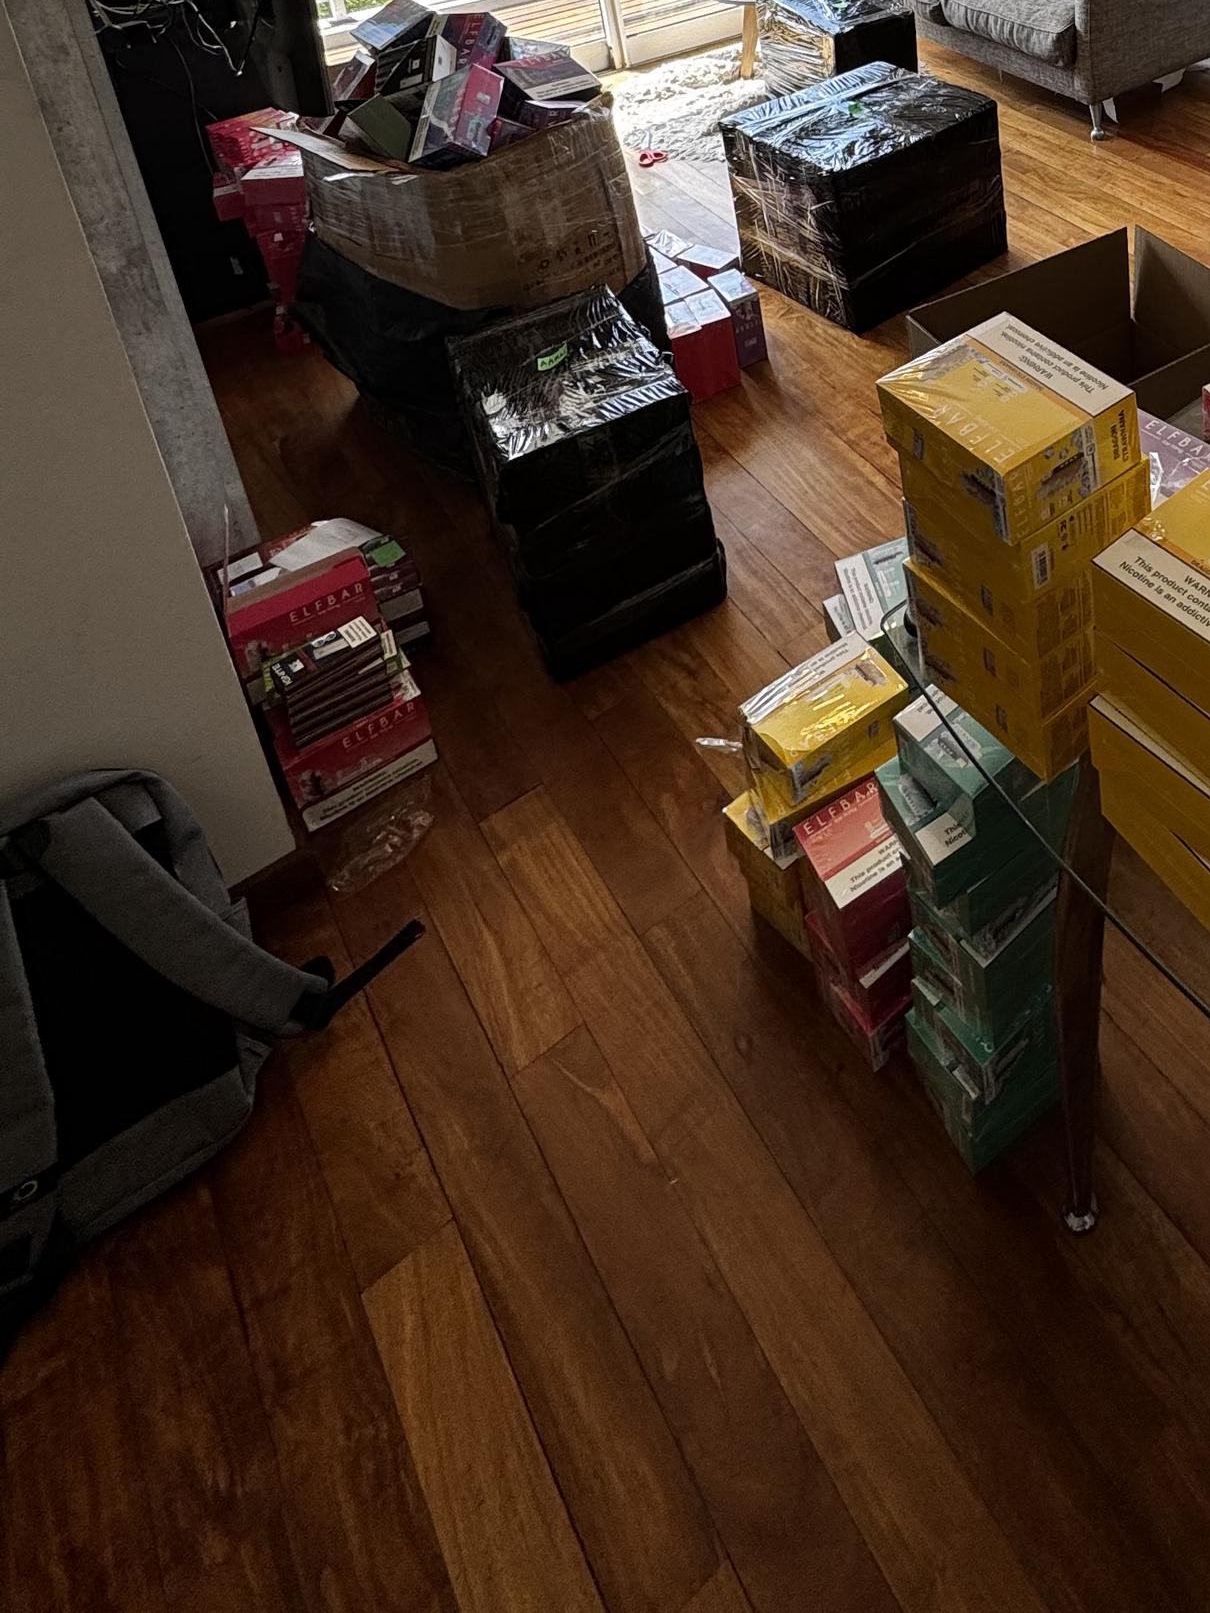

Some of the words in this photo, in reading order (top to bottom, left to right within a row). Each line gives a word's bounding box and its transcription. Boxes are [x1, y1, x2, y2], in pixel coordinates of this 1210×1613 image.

[1119, 561, 1155, 588] Nicotine
[1154, 585, 1164, 595] is
[1163, 591, 1177, 604] an
[1133, 556, 1152, 573] This
[1152, 570, 1190, 596] product
[289, 582, 363, 623] ELFBAR
[342, 702, 415, 749] ELFBAR
[803, 782, 879, 835] ELFBAR
[944, 830, 966, 847] Nicot
[850, 870, 865, 884] This
